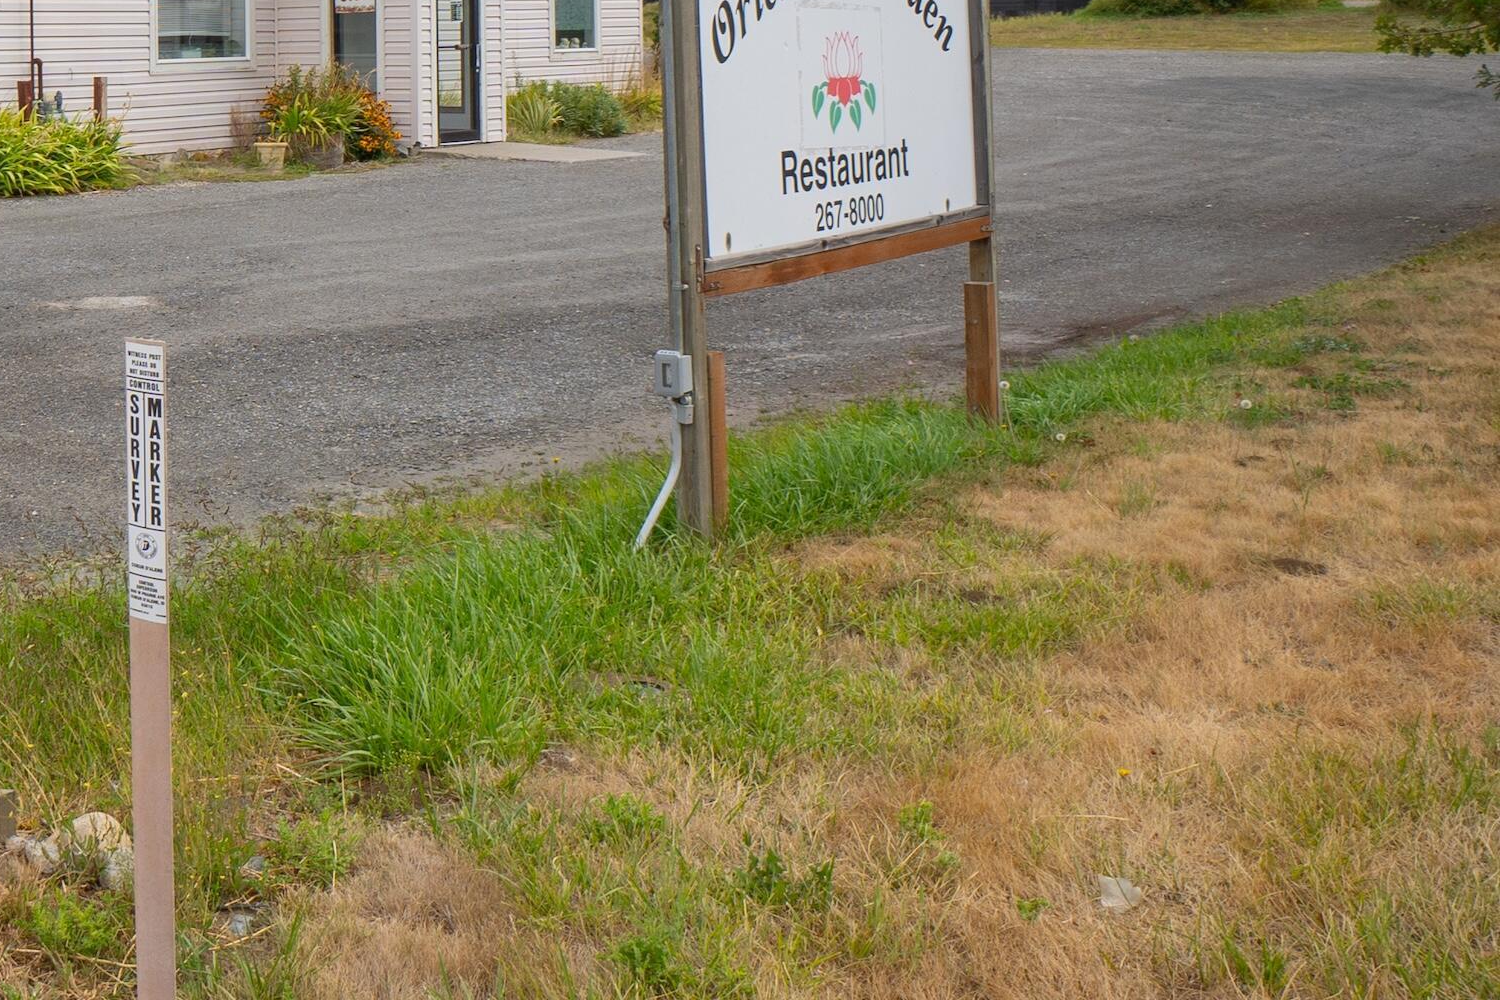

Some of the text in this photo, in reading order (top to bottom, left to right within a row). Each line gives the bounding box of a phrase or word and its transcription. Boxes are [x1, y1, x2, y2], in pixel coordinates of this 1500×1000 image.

[781, 139, 909, 195] Restaurant
[815, 193, 885, 232] 267-8000
[129, 379, 160, 392] CONTROL
[130, 394, 140, 522] SURVEY
[147, 398, 162, 526] MARKER
